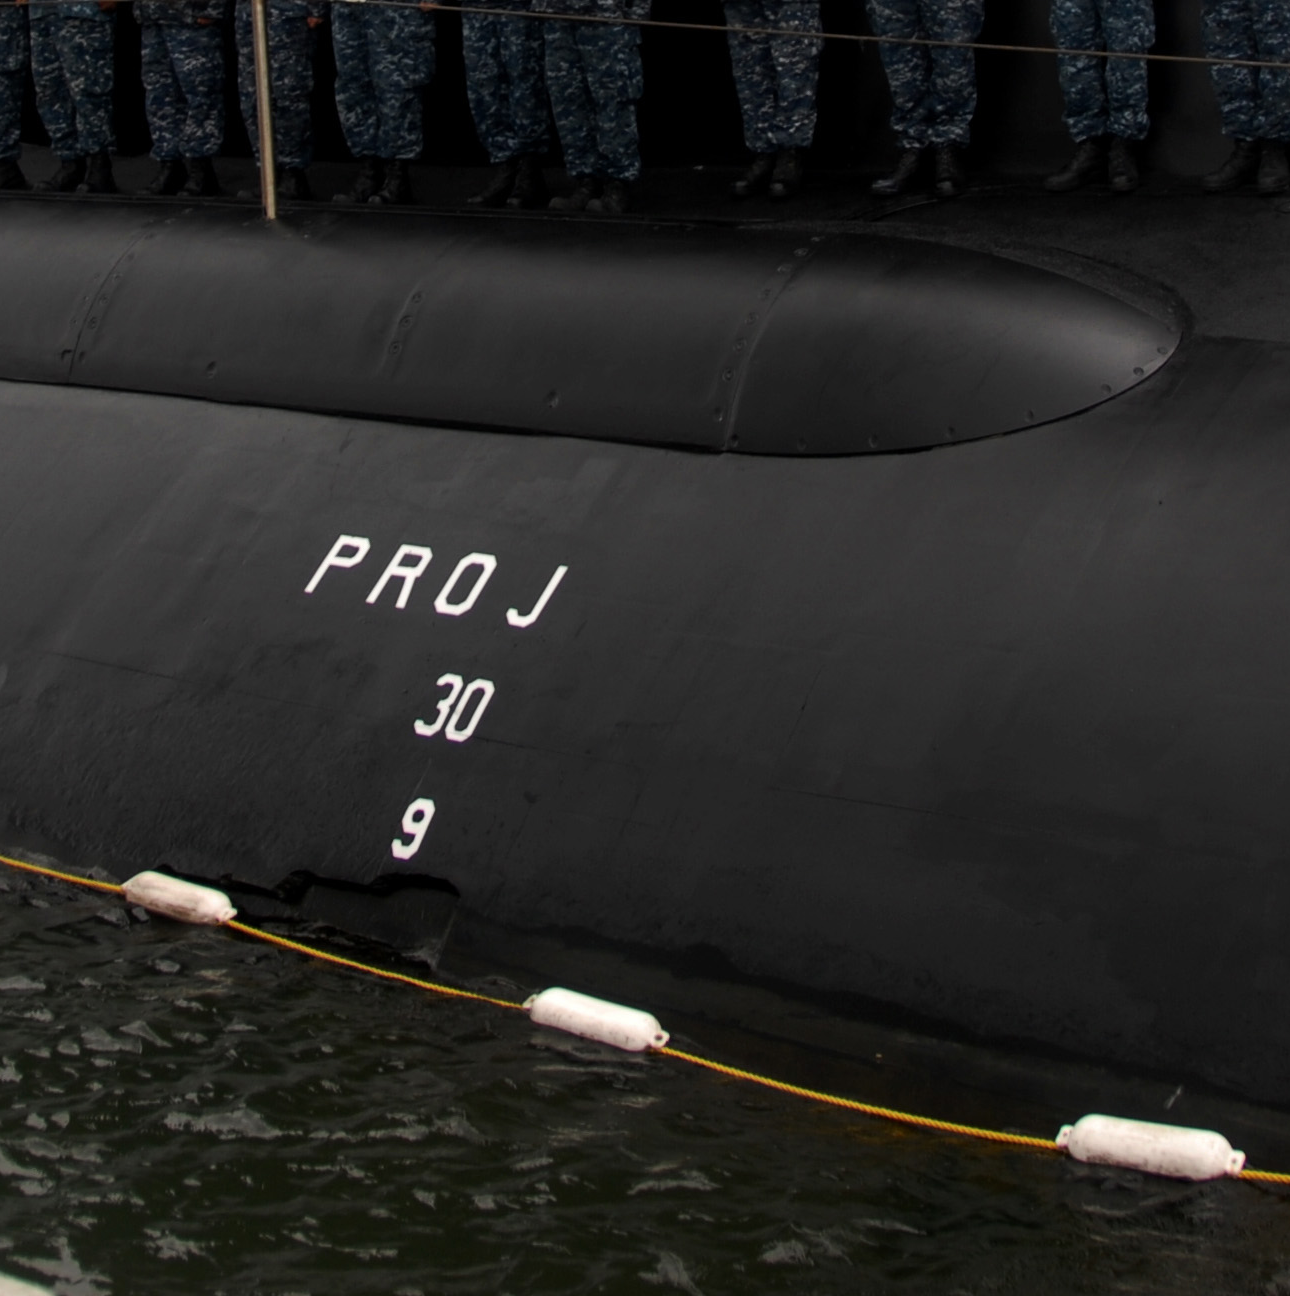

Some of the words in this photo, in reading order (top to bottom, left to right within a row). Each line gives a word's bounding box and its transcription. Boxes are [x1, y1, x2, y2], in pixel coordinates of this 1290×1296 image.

[305, 535, 568, 627] PROJ
[414, 673, 495, 742] 30
[392, 798, 435, 859] 9
